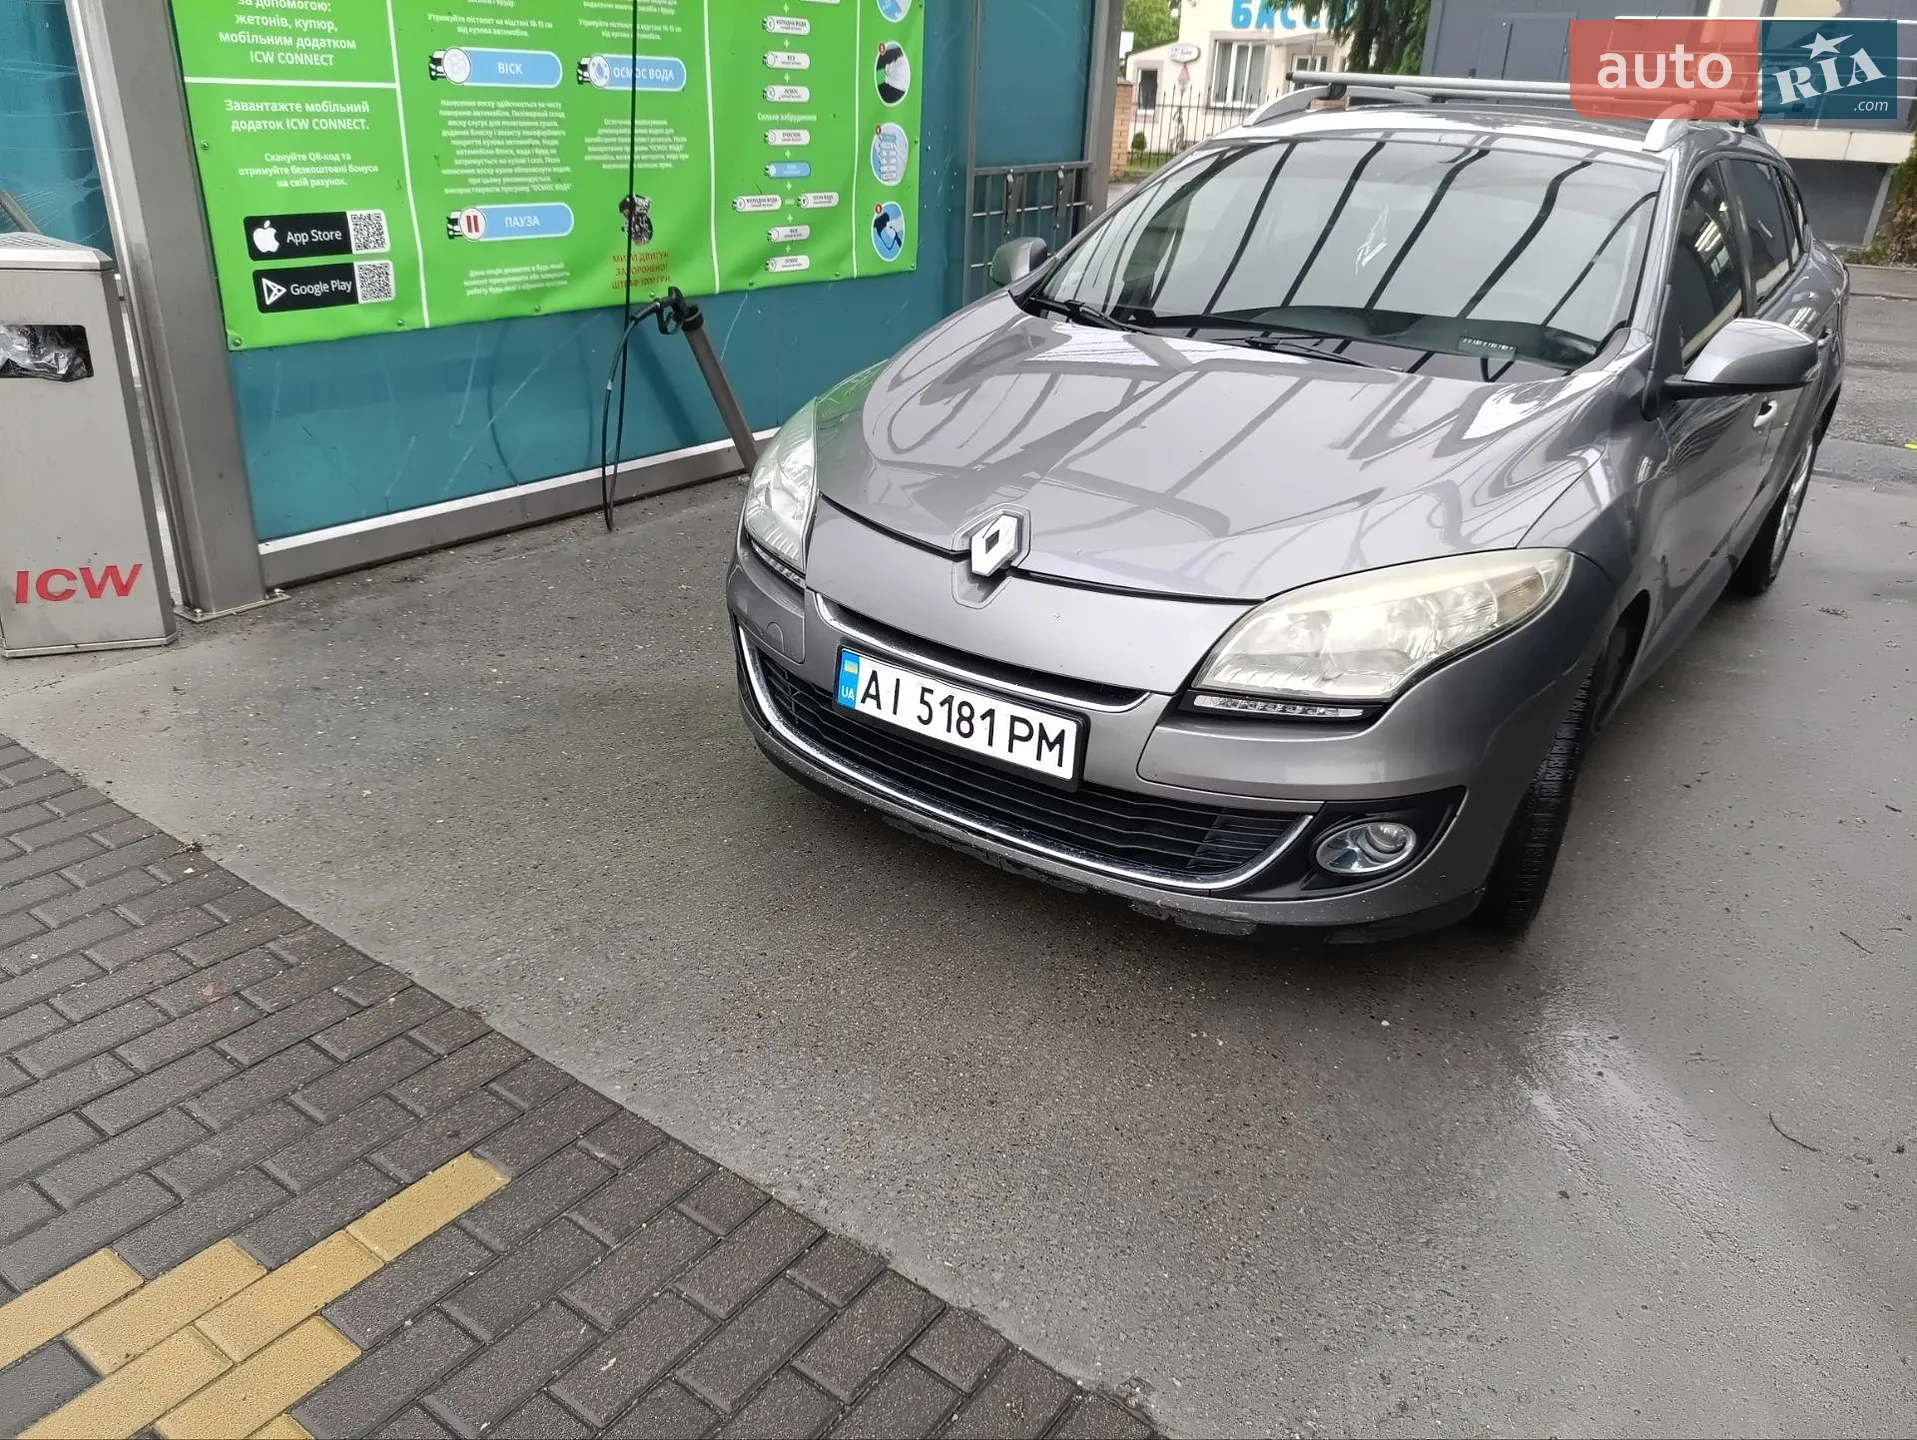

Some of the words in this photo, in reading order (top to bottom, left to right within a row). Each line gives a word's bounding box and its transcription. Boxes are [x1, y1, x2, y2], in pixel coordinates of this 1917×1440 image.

[255, 0, 332, 12] допомогою:
[235, 14, 292, 30] жетонів,
[295, 19, 338, 33] купюр,
[219, 31, 293, 47] мобільним
[296, 38, 357, 50] додатком
[250, 50, 275, 64] ICW
[277, 52, 334, 66] CONNECT
[498, 62, 523, 75] ВІСК
[649, 69, 675, 82] ВОДА
[225, 99, 302, 112] Завантажте
[305, 101, 369, 113] мобільний
[231, 119, 283, 132] додаток
[286, 118, 309, 130] ICW
[312, 119, 369, 131] CONNECT.
[264, 152, 307, 164] Скануйте
[341, 153, 352, 162] та
[505, 215, 541, 228] ПАУЗА
[286, 230, 310, 246] App
[311, 228, 342, 241] Store
[290, 282, 329, 298] Google
[331, 280, 352, 294] Play
[15, 563, 143, 604] ICW
[840, 685, 856, 700] UA
[860, 669, 901, 716] AI
[916, 686, 996, 747] 5181
[1008, 714, 1066, 768] PM
